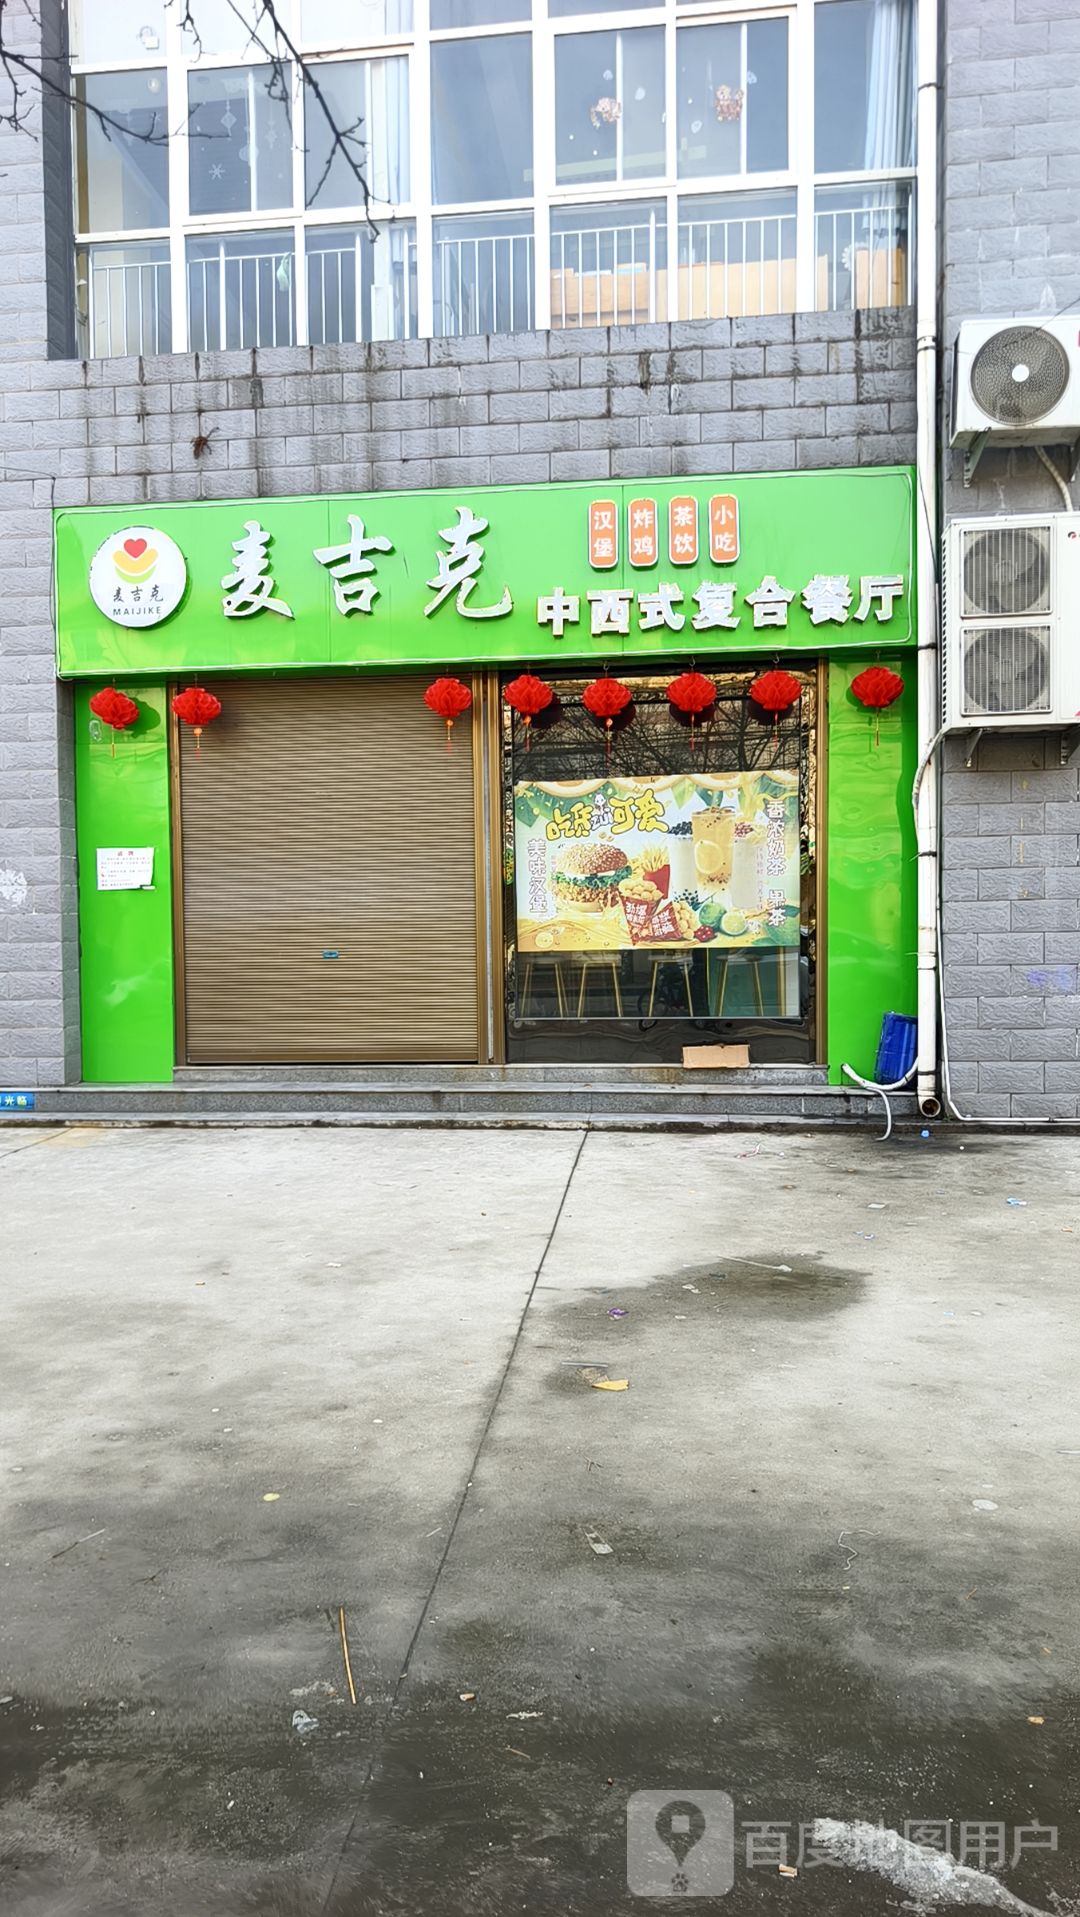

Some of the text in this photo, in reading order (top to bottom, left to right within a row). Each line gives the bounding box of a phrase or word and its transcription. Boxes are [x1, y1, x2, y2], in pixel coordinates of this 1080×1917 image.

[593, 511, 614, 557] 汉堡
[633, 508, 654, 556] 炸鸡
[673, 506, 695, 554] 茶饮
[714, 505, 736, 552] 小吃
[220, 506, 513, 619] 麦吉克
[112, 606, 162, 616] MAIJIKE
[113, 584, 164, 602] 麦吉克
[537, 575, 904, 637] 中西式复合餐厅
[528, 838, 547, 914] 美味汉堡
[767, 800, 786, 927] 香浓奶茶 果茶
